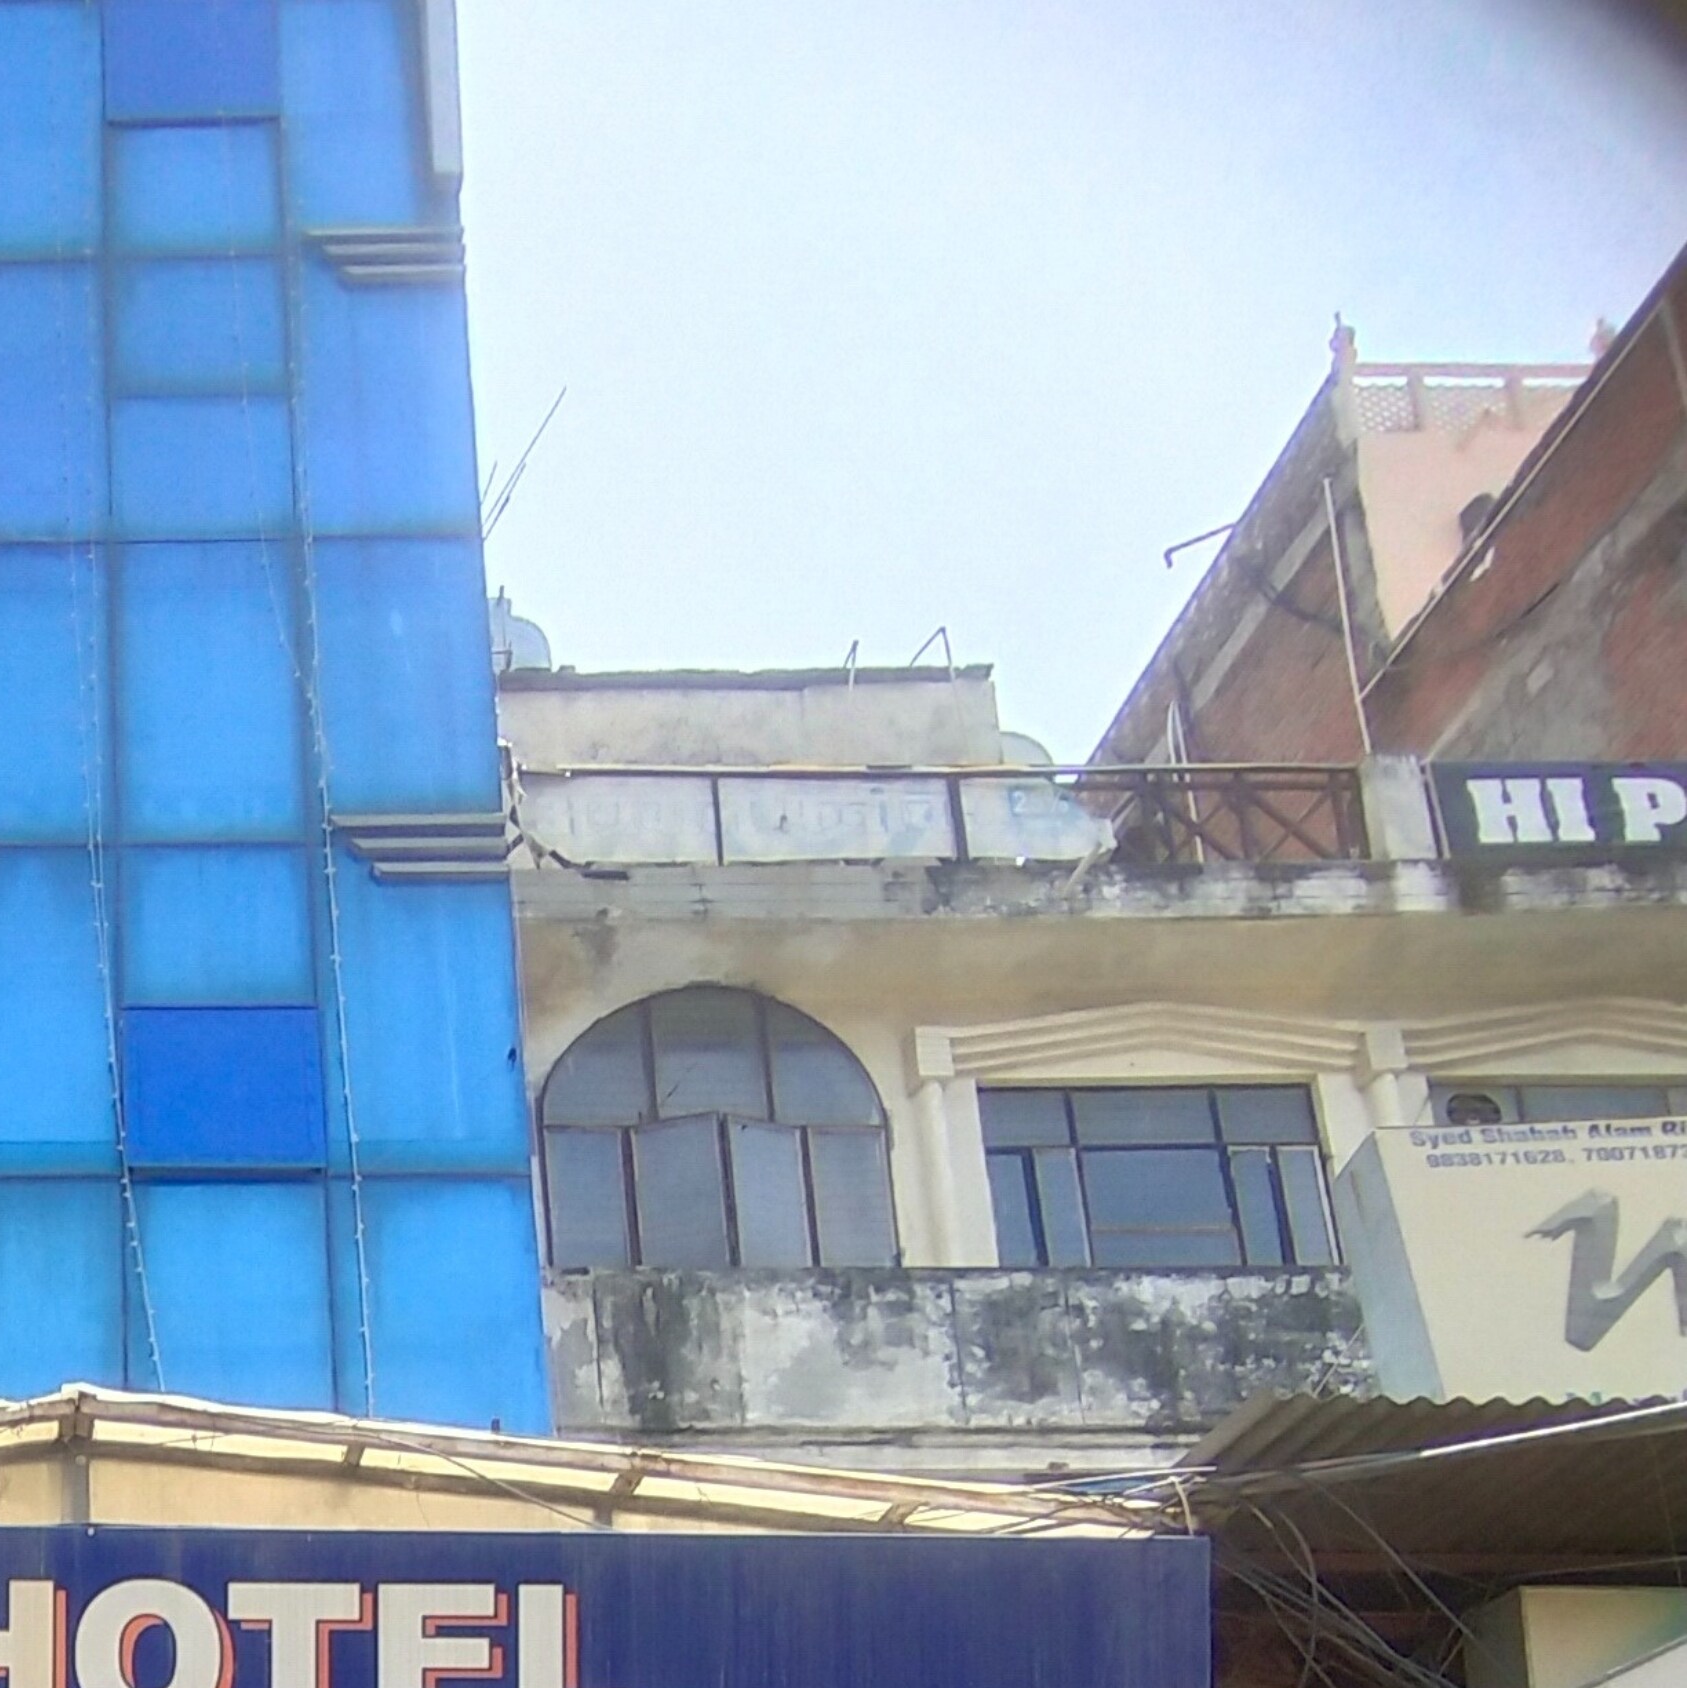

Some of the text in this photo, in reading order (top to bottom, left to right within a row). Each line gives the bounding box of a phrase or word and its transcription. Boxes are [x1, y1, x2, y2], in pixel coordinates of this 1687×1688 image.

[1466, 777, 1687, 843] HI P
[1661, 1119, 1687, 1137] Ri
